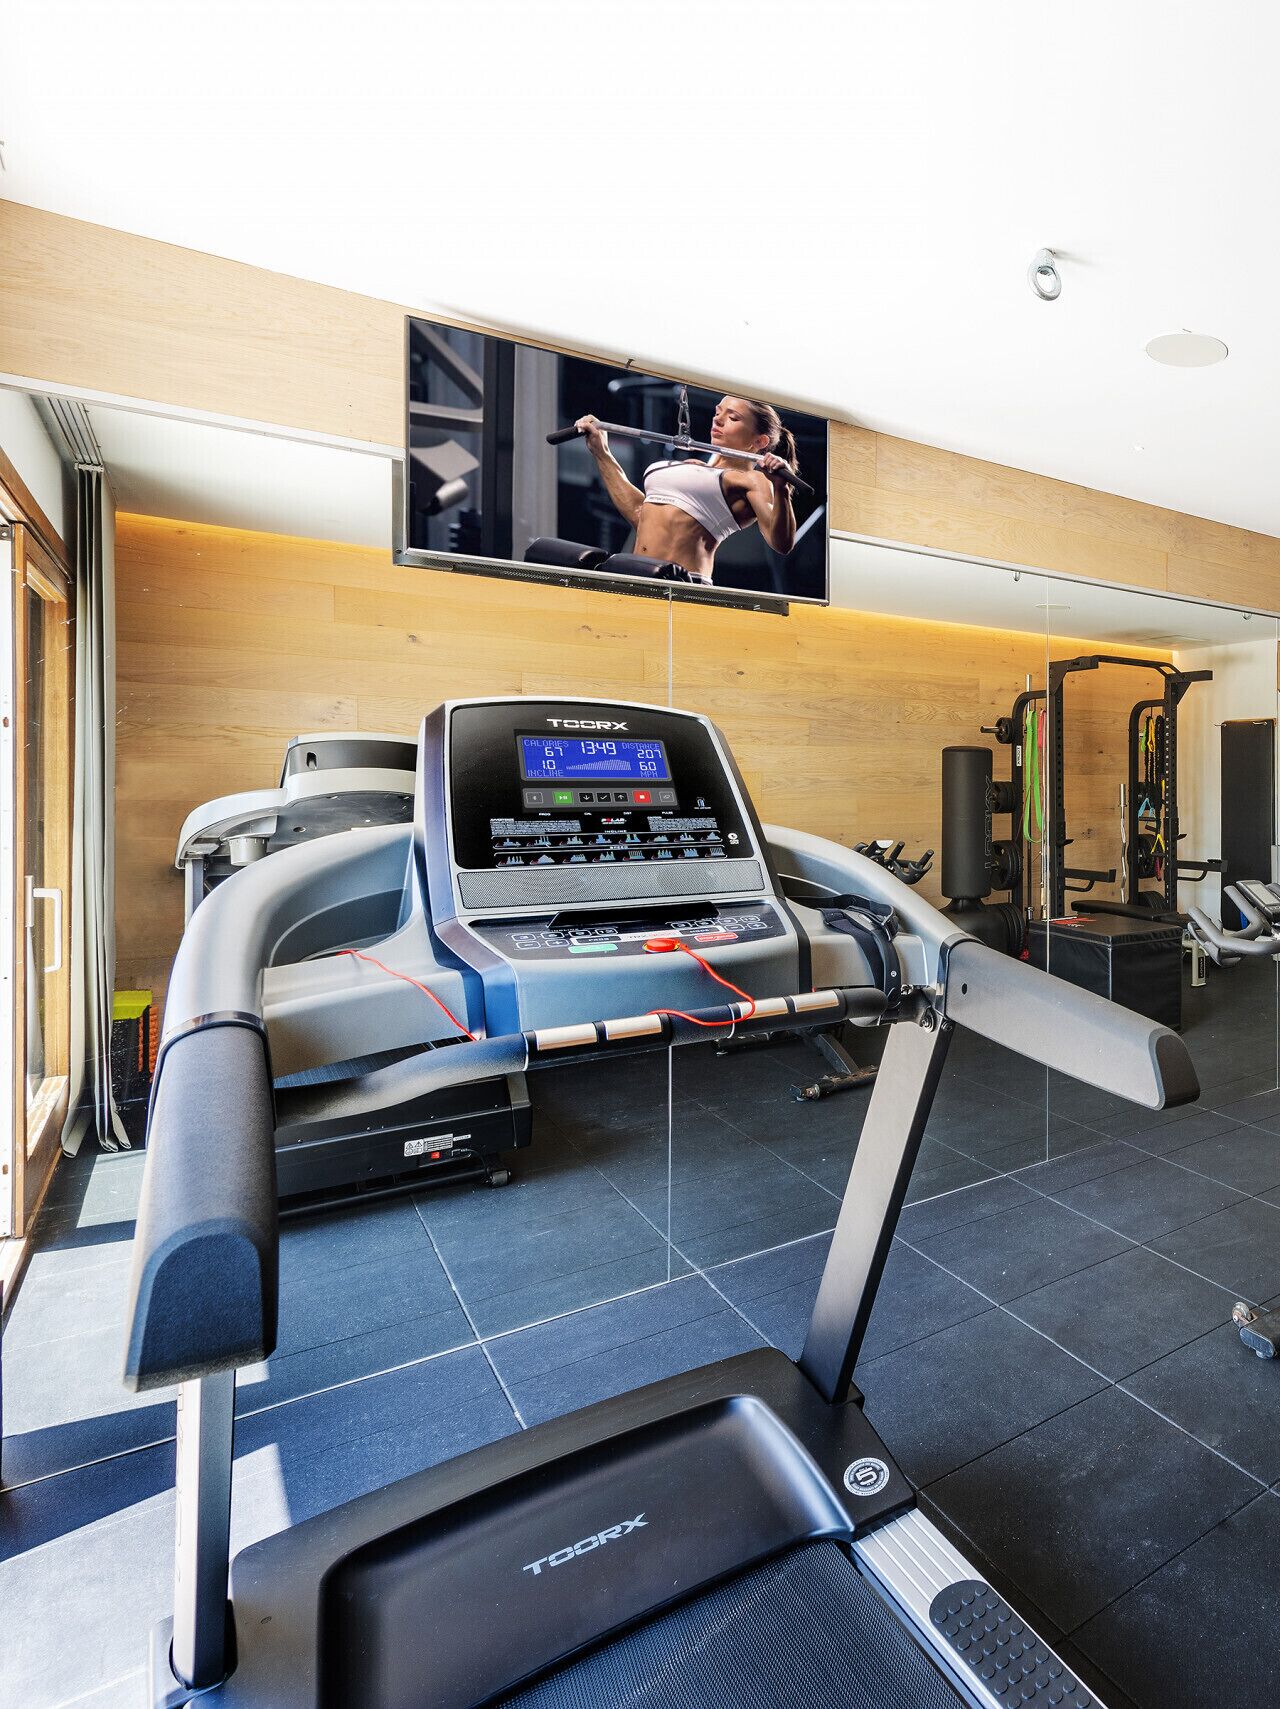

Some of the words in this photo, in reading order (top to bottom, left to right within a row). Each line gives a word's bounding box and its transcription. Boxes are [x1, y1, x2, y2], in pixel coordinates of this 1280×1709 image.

[546, 718, 630, 731] TOORX
[524, 739, 569, 748] CALORIES
[621, 742, 660, 751] DISTANCE
[545, 747, 564, 757] 67
[527, 769, 564, 778] INCLINE
[522, 1512, 650, 1575] TOORX
